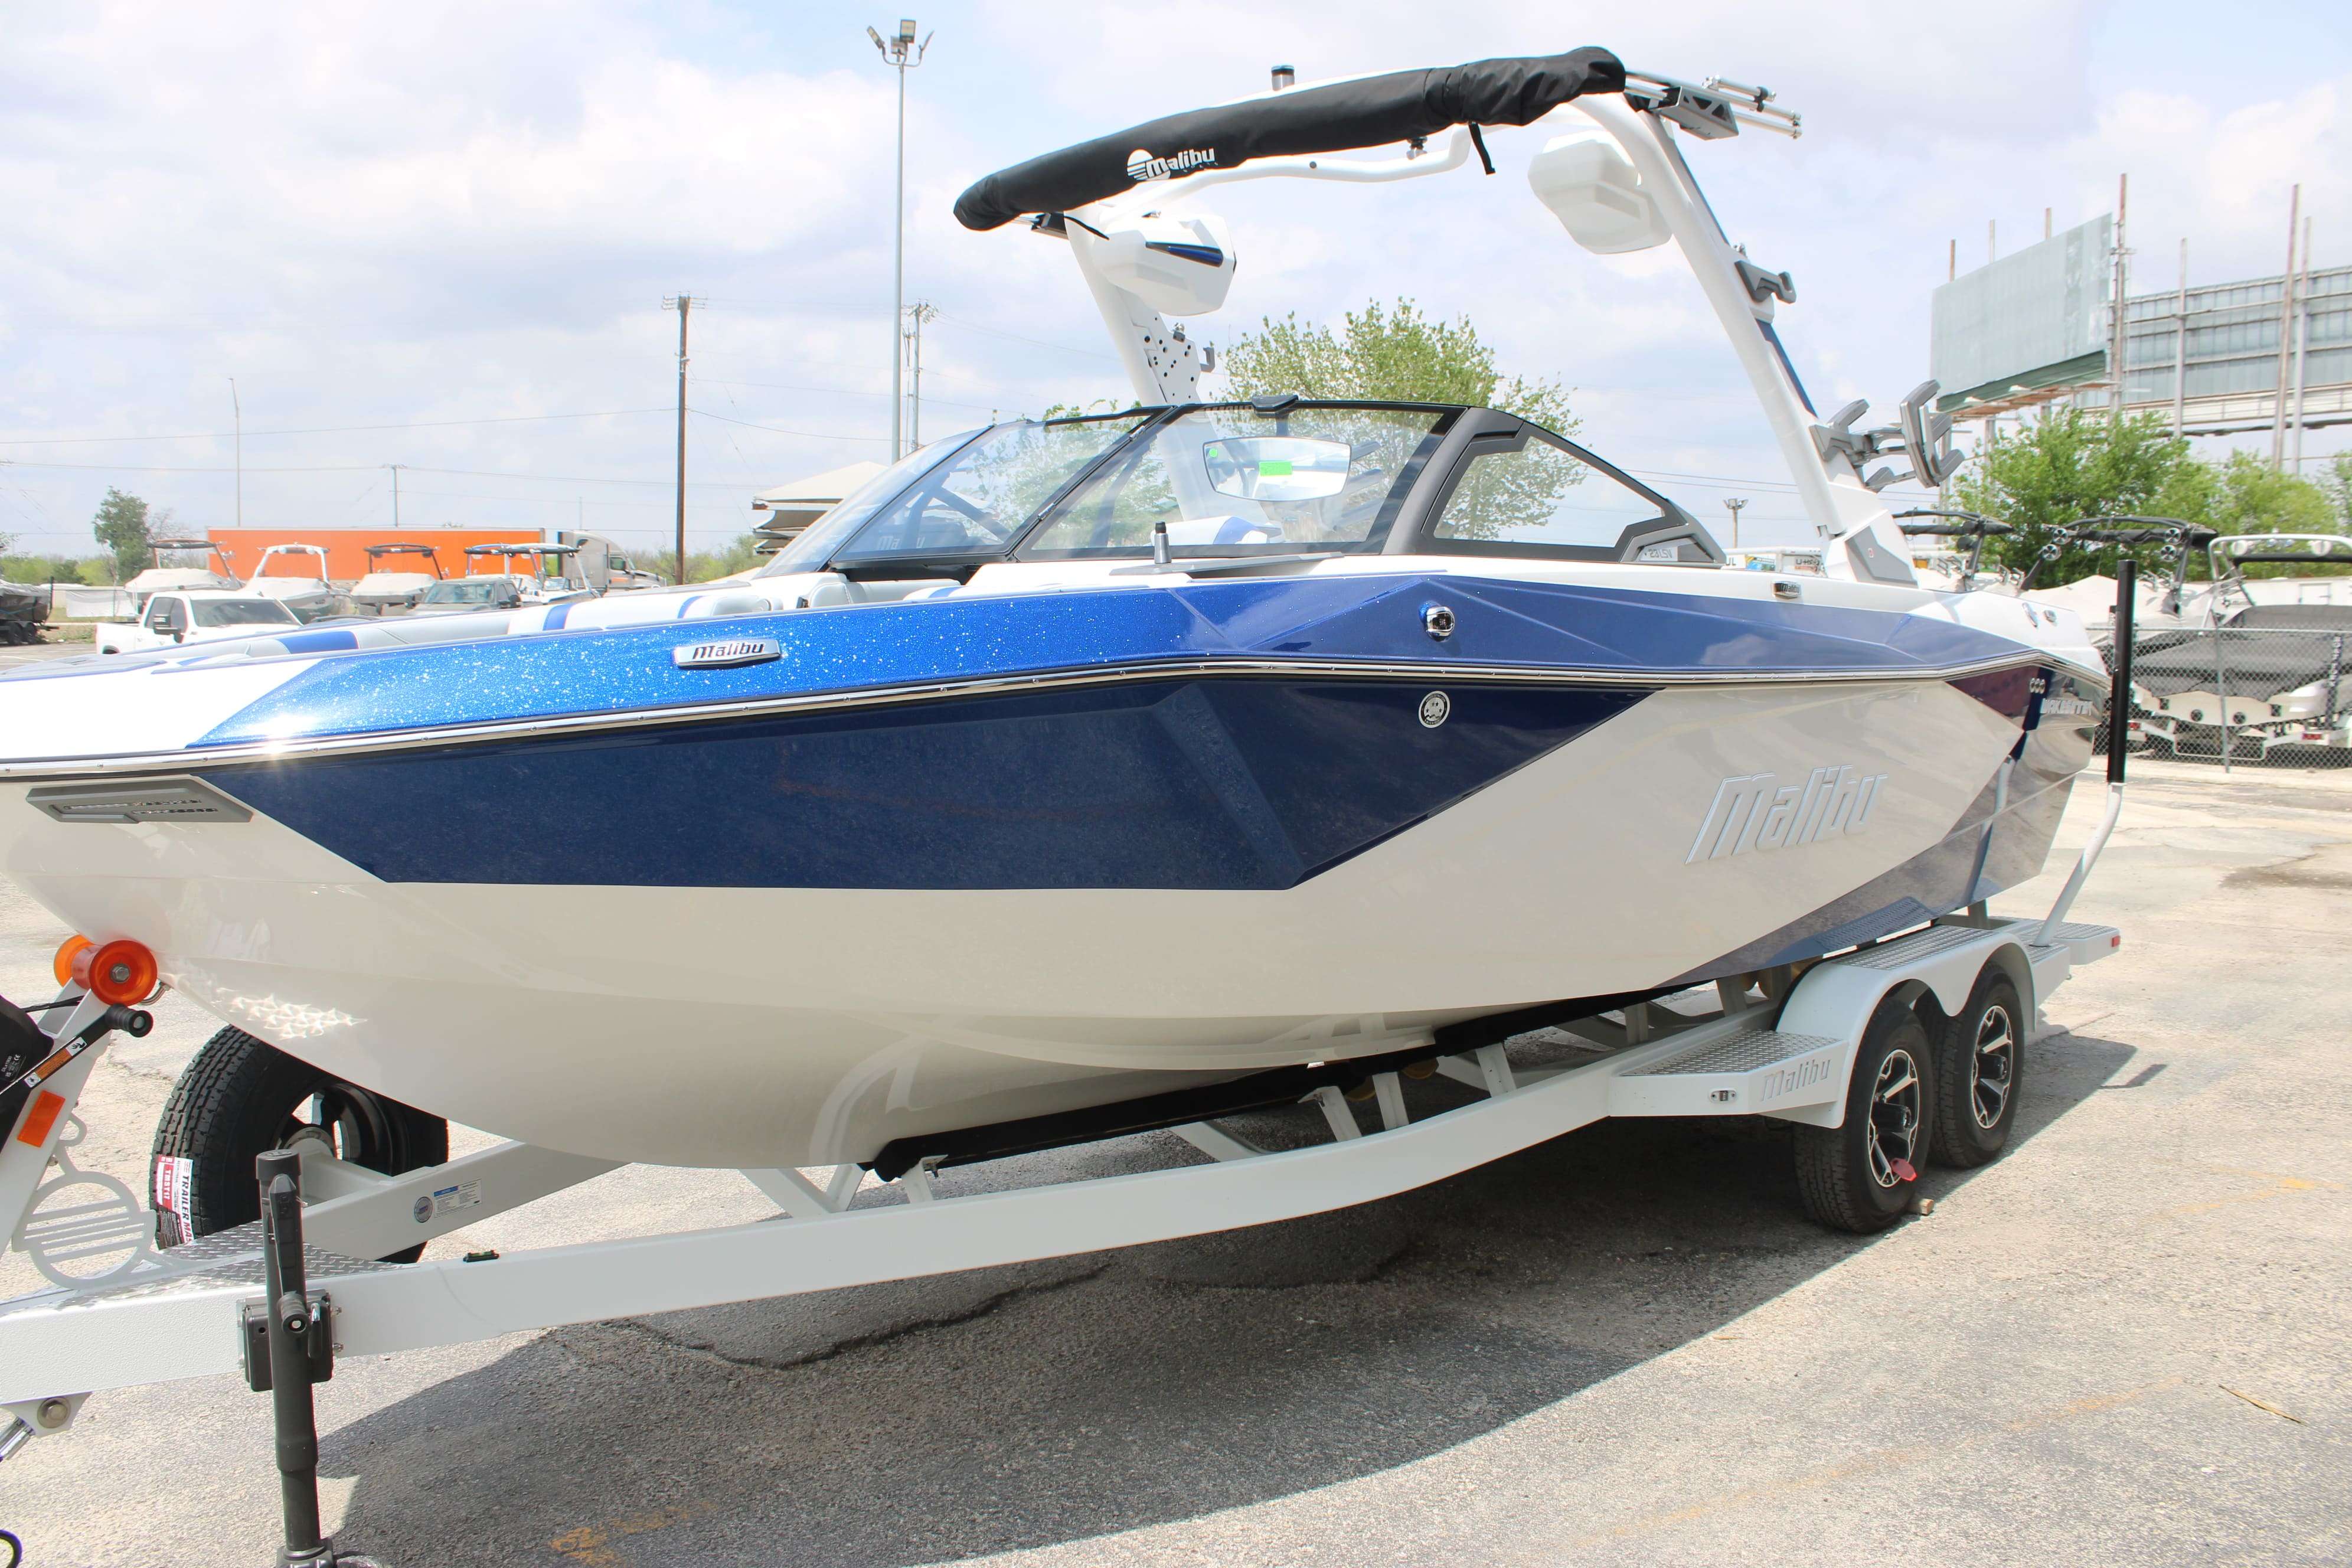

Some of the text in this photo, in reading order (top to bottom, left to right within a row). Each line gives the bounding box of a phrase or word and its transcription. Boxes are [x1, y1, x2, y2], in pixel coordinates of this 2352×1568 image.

[692, 642, 765, 659] Malibu
[1684, 765, 1889, 865] Malibu
[1760, 1059, 1831, 1102] Malibu
[181, 1175, 190, 1221] TRAILER
